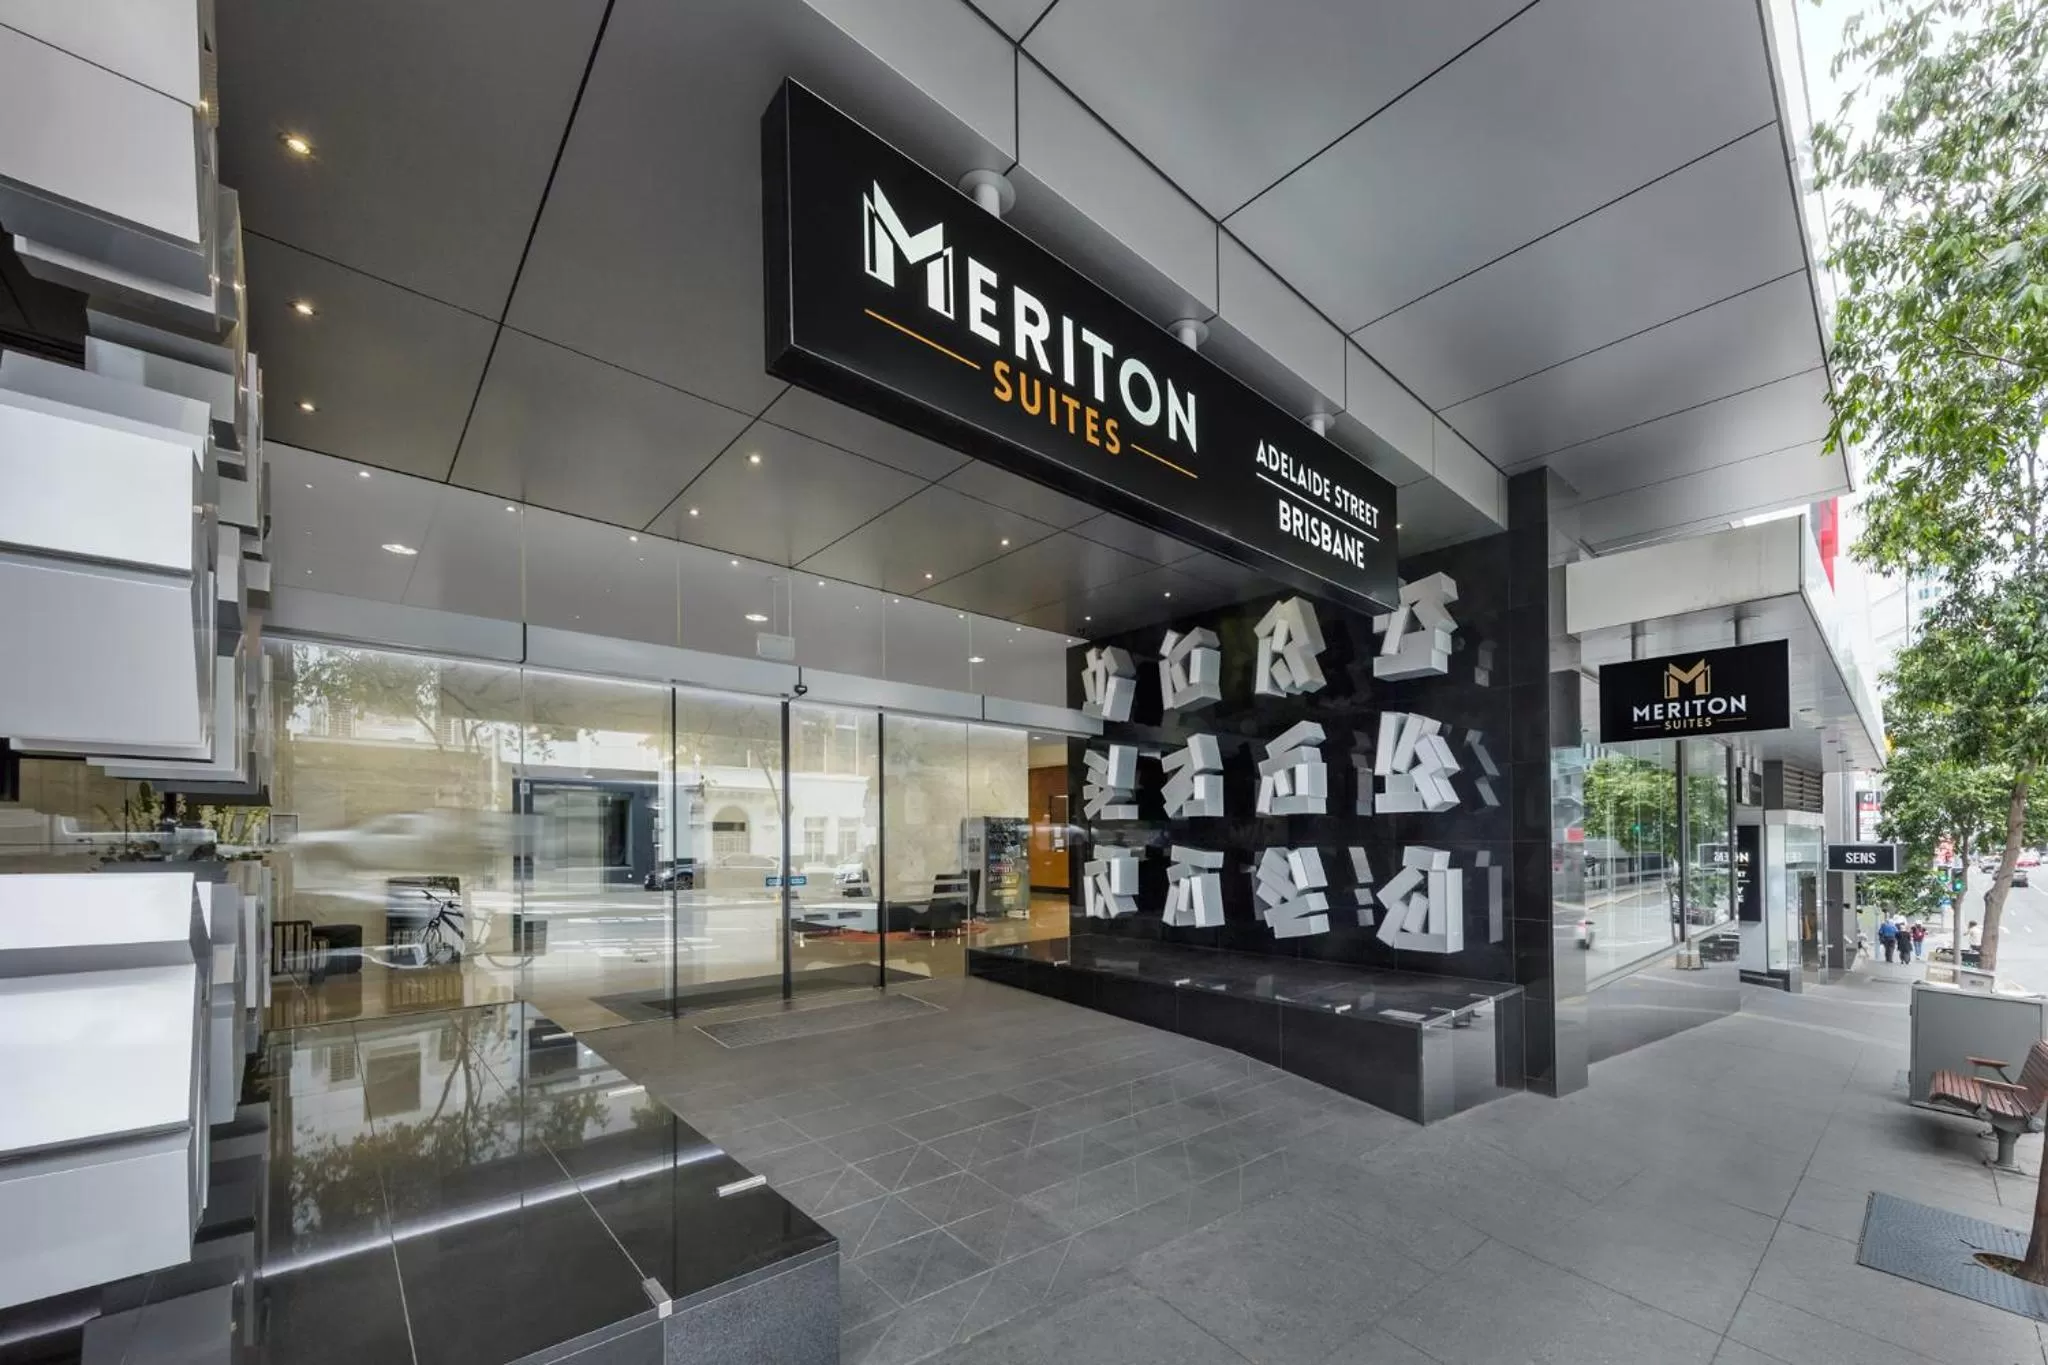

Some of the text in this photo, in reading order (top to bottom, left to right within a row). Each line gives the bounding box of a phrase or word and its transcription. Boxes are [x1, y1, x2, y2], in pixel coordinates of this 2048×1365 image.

[863, 179, 1197, 454] MERITON
[993, 359, 1121, 455] SUITES
[1255, 440, 1380, 530] ADELAIDE STREET
[1278, 499, 1366, 570] BRISBANE
[1632, 694, 1748, 723] MERITON
[1664, 716, 1713, 731] SUITES
[1845, 851, 1877, 864] SENS
